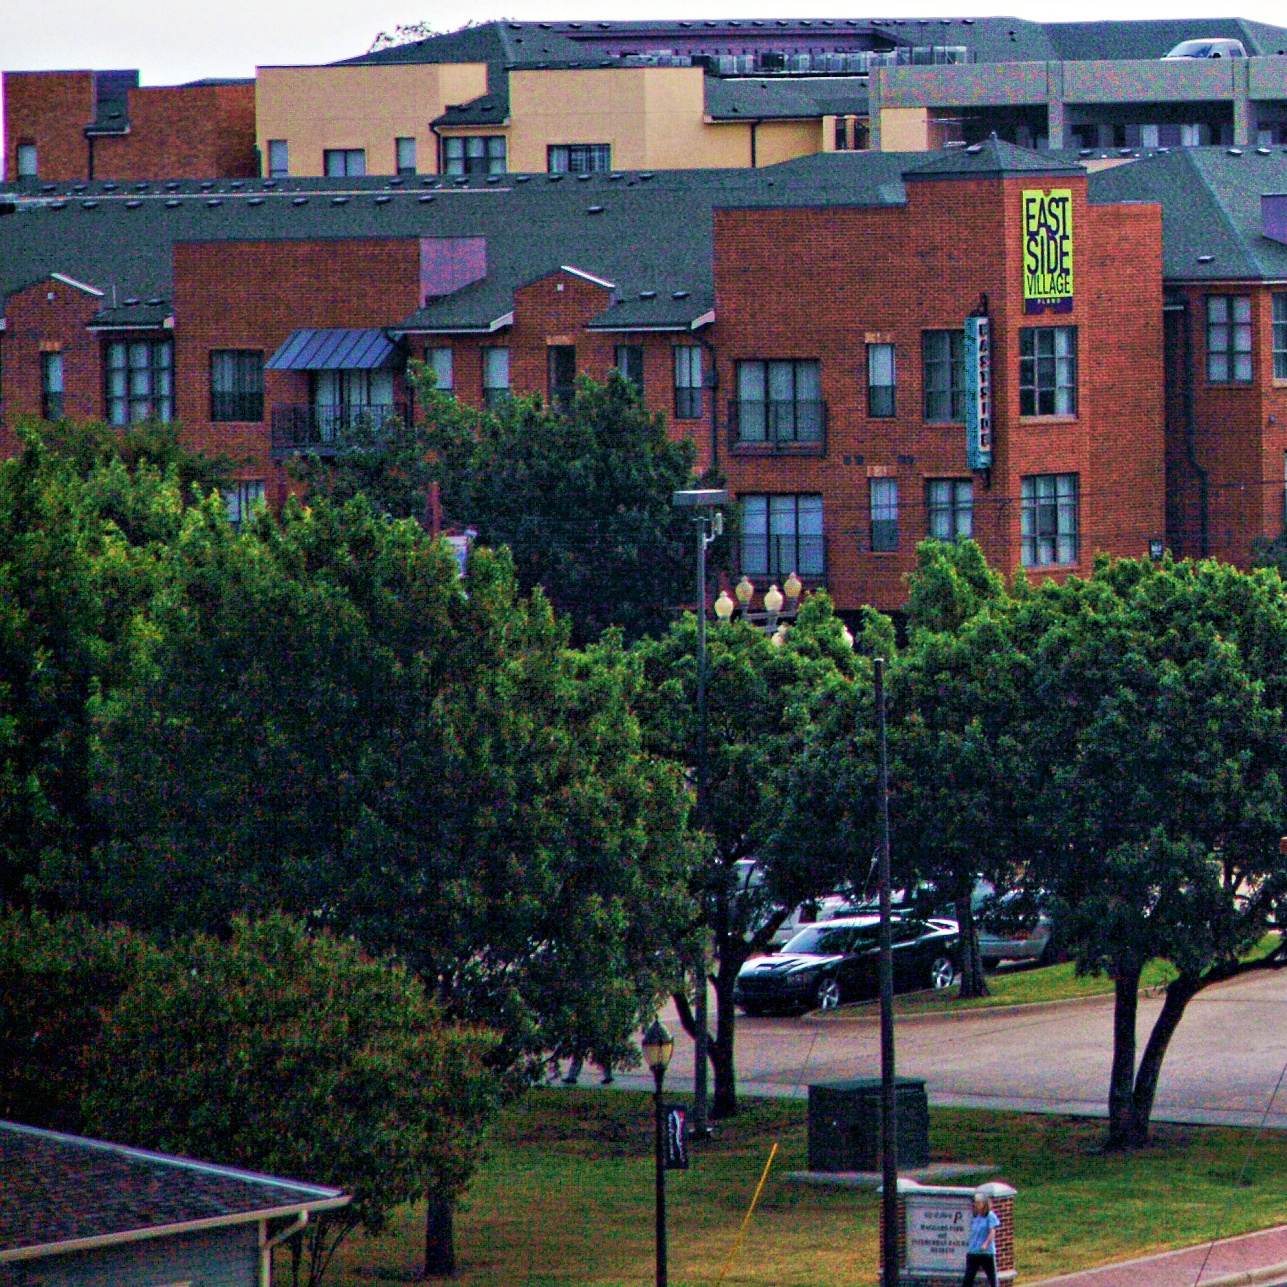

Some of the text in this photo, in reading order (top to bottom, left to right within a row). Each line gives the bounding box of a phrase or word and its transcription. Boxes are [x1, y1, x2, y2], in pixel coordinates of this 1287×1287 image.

[1026, 197, 1069, 236] EAST
[1027, 233, 1070, 275] SIDE
[1027, 273, 1070, 295] VILLAGE
